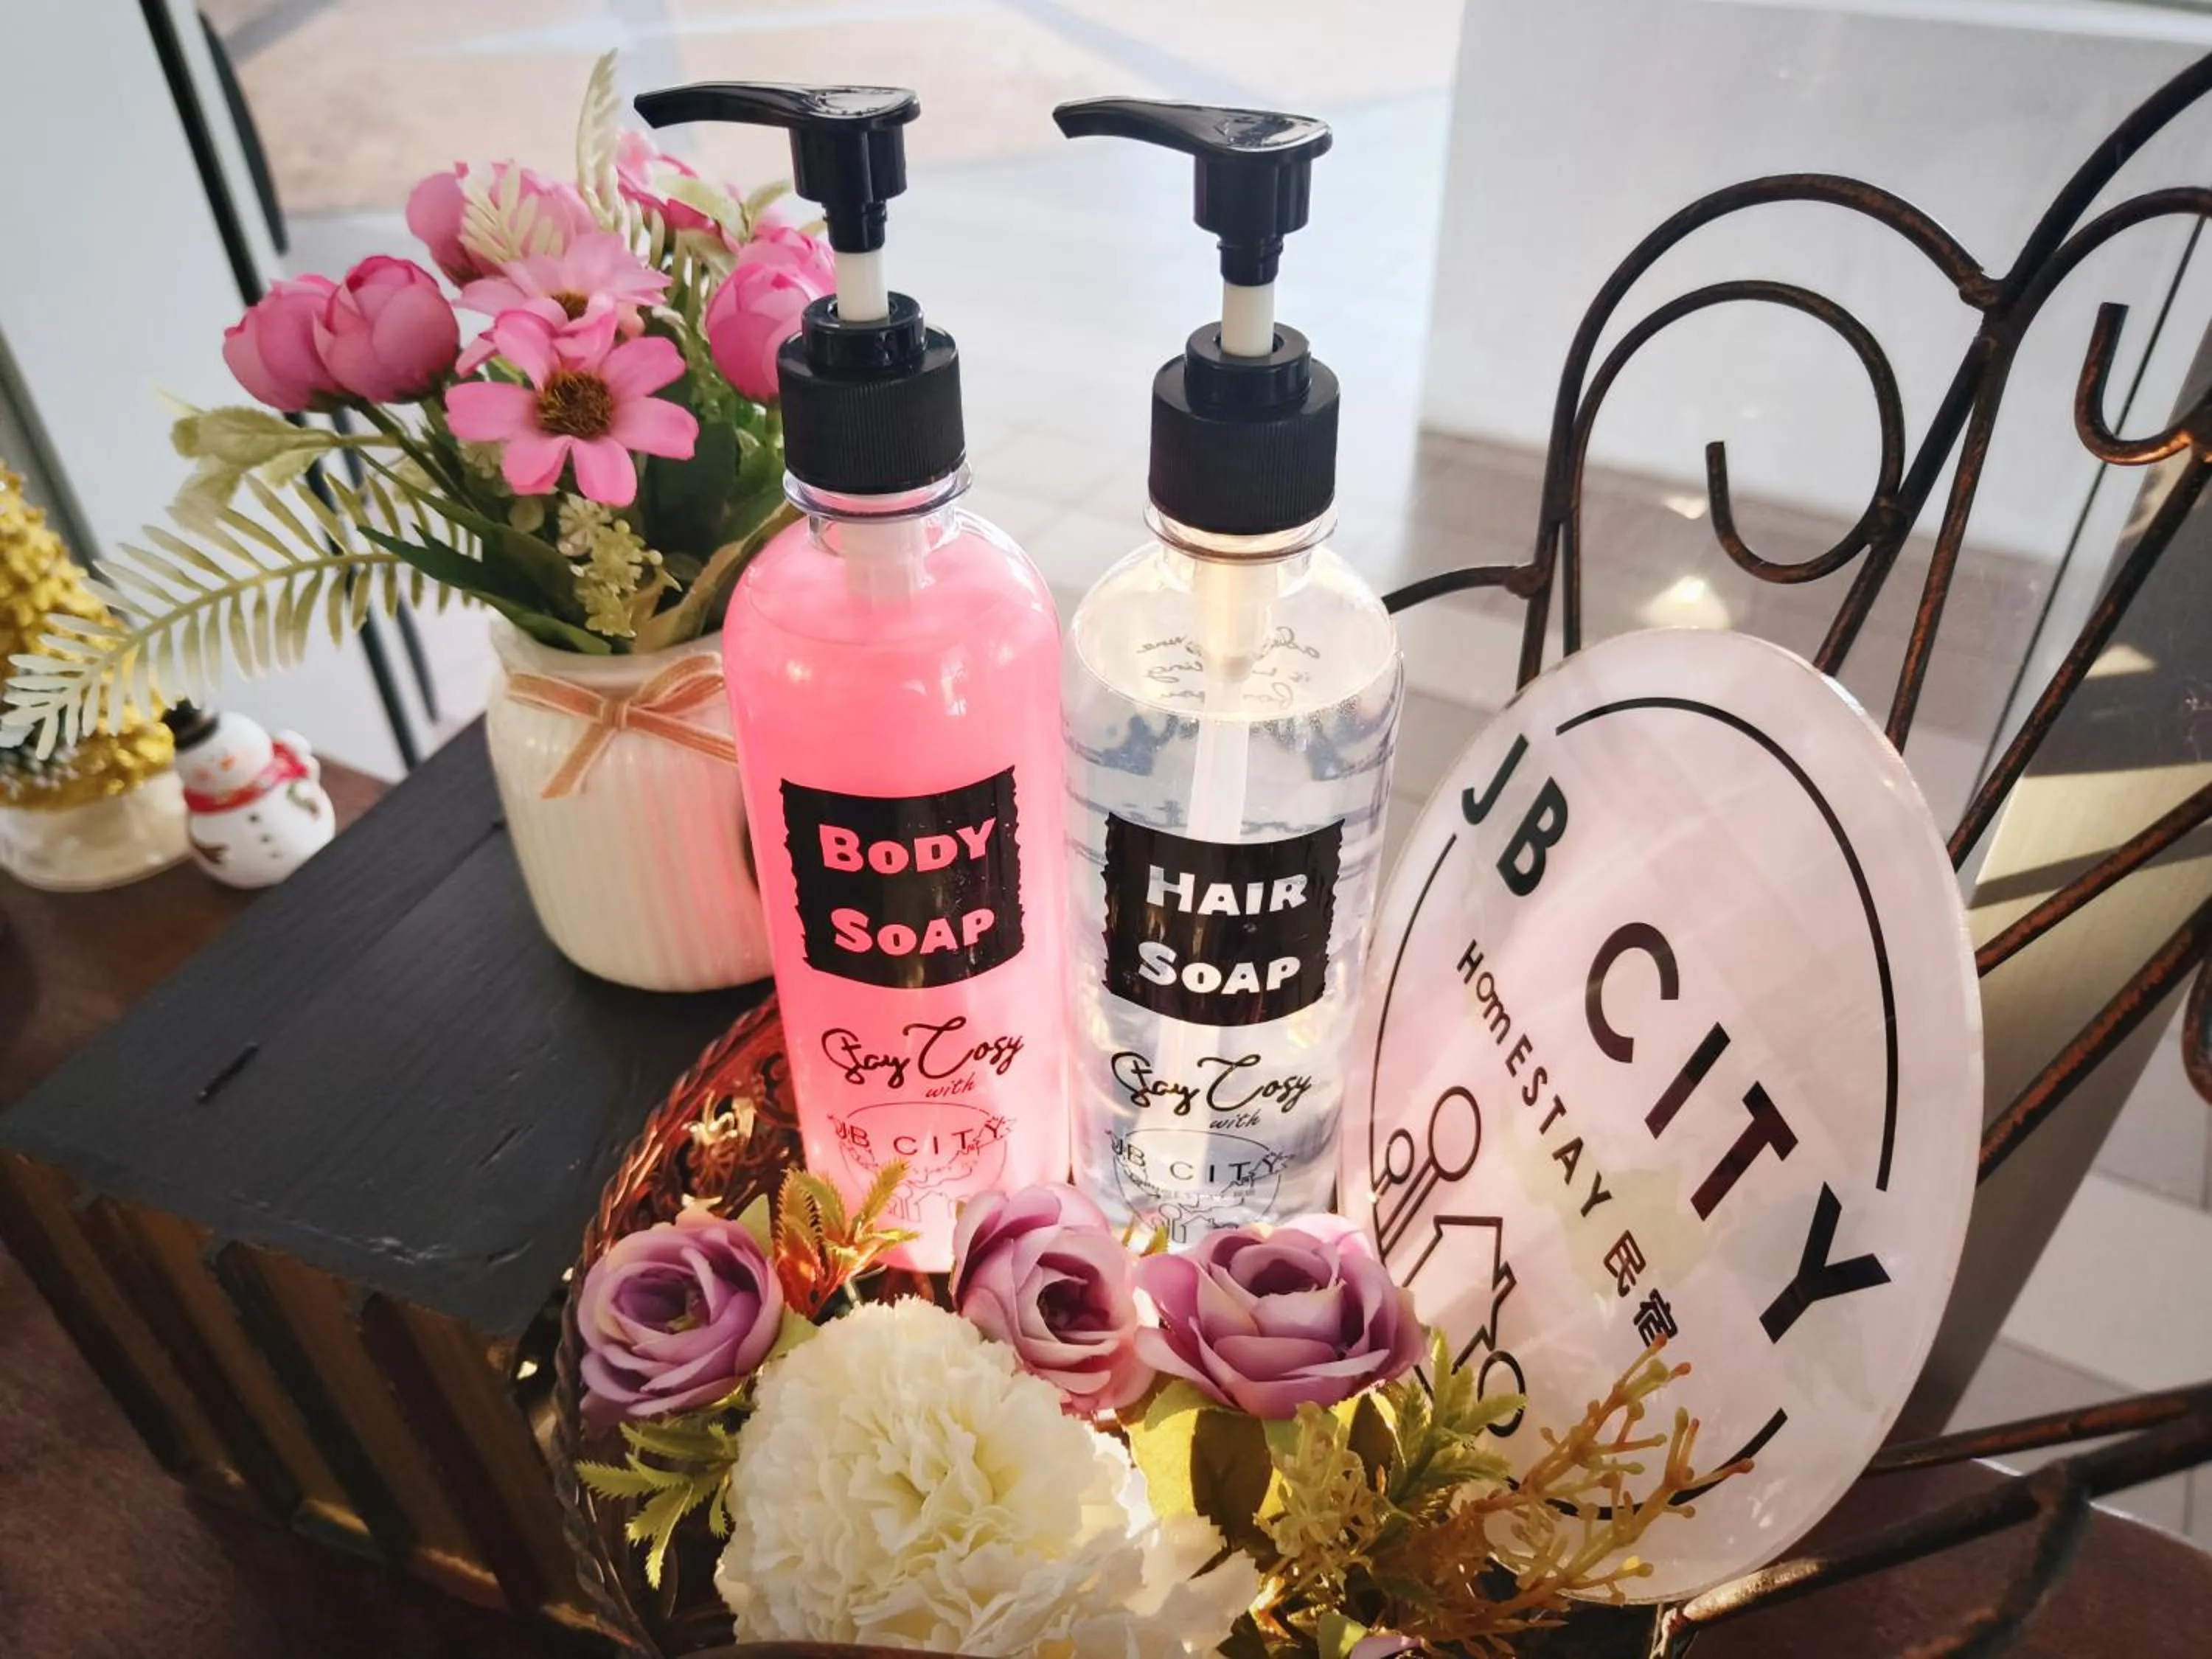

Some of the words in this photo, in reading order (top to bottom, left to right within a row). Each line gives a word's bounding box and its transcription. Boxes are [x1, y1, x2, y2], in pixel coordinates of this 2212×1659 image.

[1147, 864, 1307, 916] HAIR
[1461, 734, 1568, 897] JB
[1585, 922, 1891, 1344] CITY
[925, 1072, 975, 1098] with
[836, 1121, 871, 1148] JB
[893, 1116, 1004, 1155] CITY
[1209, 1109, 1261, 1129] with
[1111, 1139, 1146, 1167] JB
[1169, 1152, 1283, 1183] CITY
[1603, 1229, 1678, 1348] 民宿
